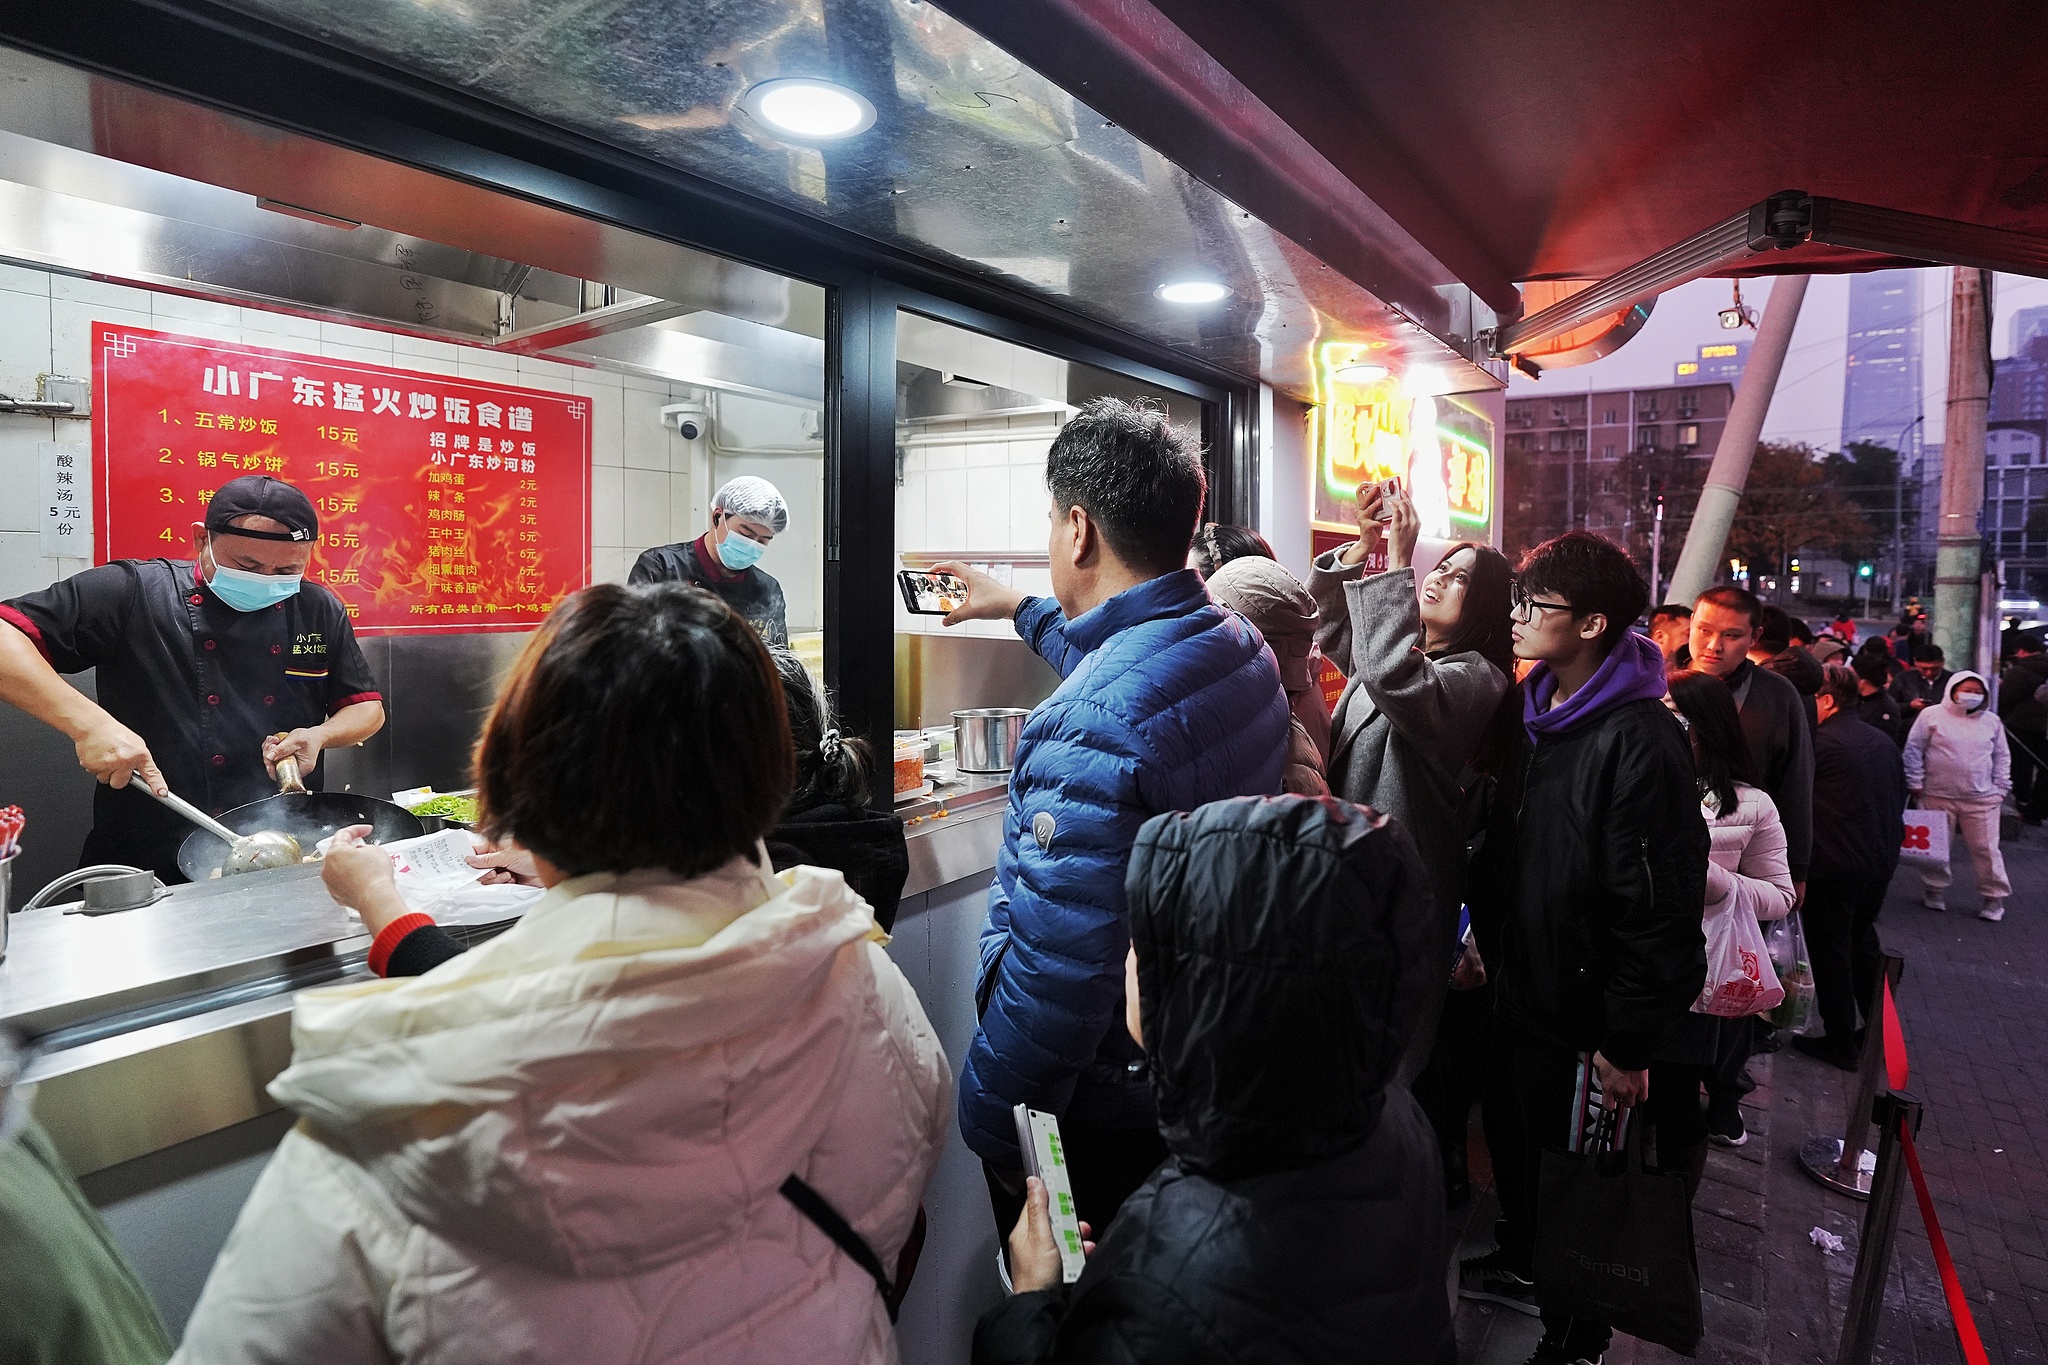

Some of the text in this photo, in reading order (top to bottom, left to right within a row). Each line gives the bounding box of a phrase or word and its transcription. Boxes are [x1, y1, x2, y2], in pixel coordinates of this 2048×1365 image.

[202, 364, 533, 432] 小广东猛火炒饭食谱
[158, 408, 358, 443] 1、五常炒饭 15元
[429, 431, 536, 457] 招牌是炒饭
[158, 447, 359, 478] 2、锅气炒饼 15元
[430, 450, 536, 474] 小广东炒河粉
[428, 471, 537, 491] 加鸡蛋 2元
[316, 497, 358, 514] 15元
[428, 489, 537, 508] 辣条 2元
[427, 508, 537, 525] 鸡肉肠 3元
[317, 533, 360, 549] 15元
[428, 527, 537, 542] 王中王 5元
[428, 545, 537, 559] 猪肉丝 6元
[316, 569, 360, 584] 15元
[428, 563, 537, 577] 烟熏腊肉 6元
[427, 582, 537, 594] 广味香肠 6元
[409, 602, 552, 615] 所有品类自带一个鸡蛋
